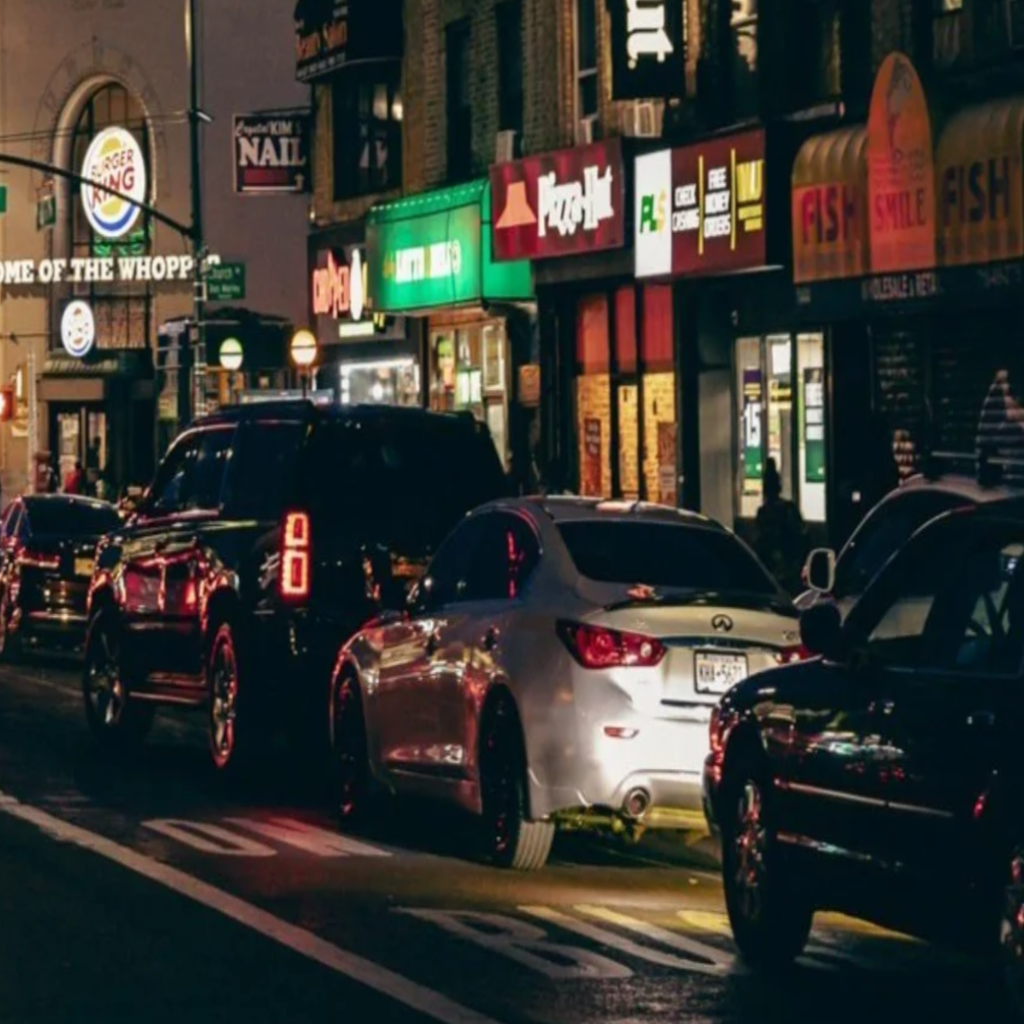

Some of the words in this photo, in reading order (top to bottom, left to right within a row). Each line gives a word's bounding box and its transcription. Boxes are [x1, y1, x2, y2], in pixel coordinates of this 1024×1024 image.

[91, 148, 134, 178] BURGER
[237, 135, 307, 167] NAIL
[91, 166, 136, 210] KING
[537, 170, 583, 237] Pizza
[583, 164, 615, 230] Hut
[874, 187, 928, 232] SMILE
[941, 155, 1012, 228] FISH
[801, 183, 856, 245] FISH
[38, 258, 69, 284] OF
[71, 256, 114, 283] THE
[117, 253, 222, 282] WHOPP
[389, 903, 740, 978] BU
